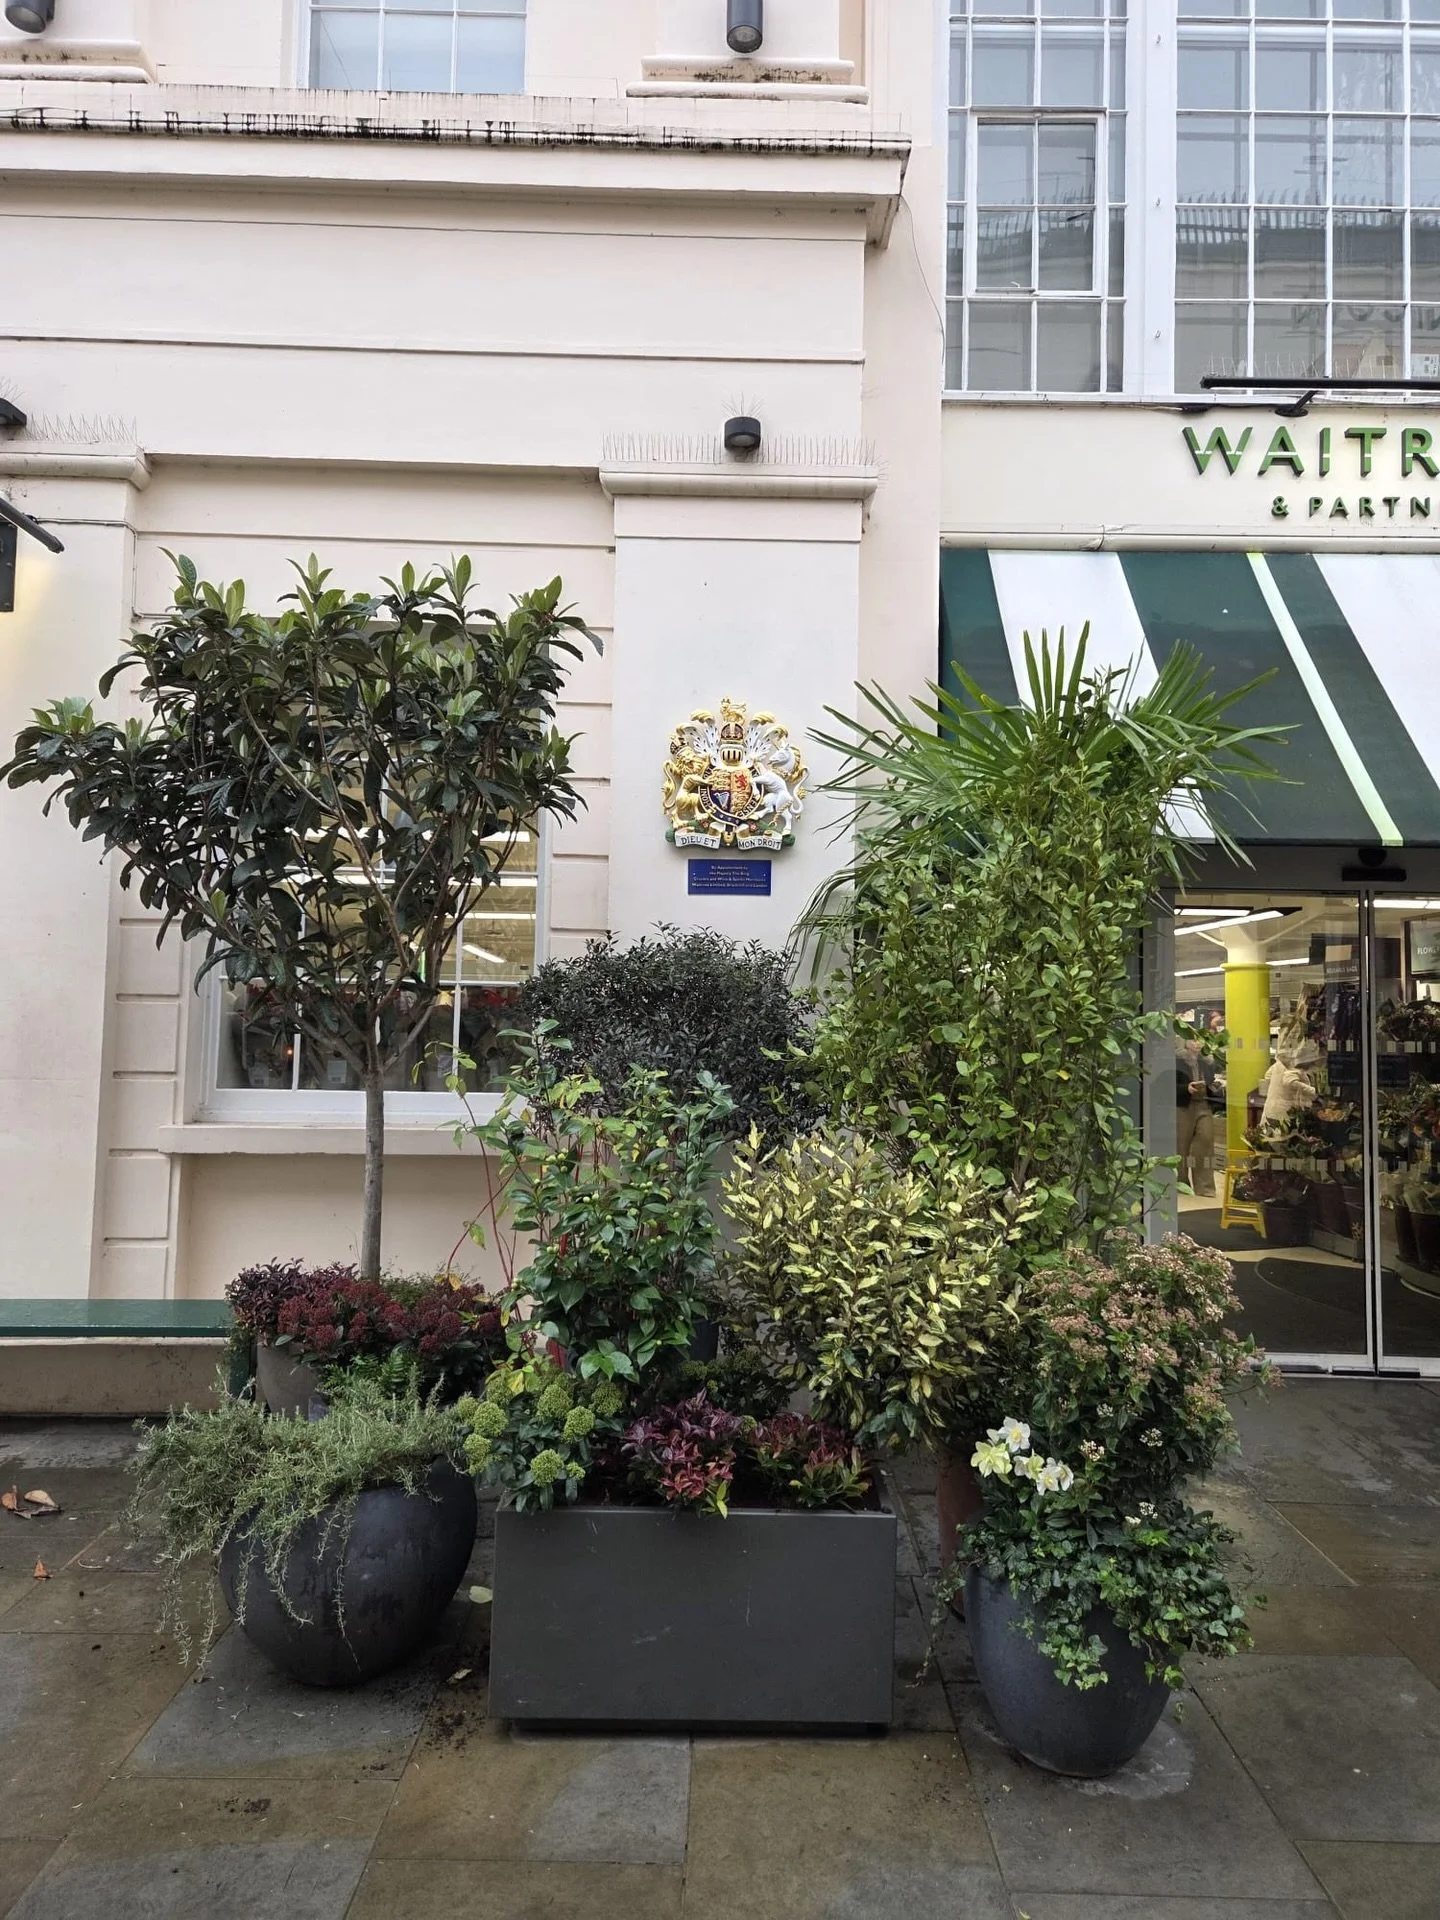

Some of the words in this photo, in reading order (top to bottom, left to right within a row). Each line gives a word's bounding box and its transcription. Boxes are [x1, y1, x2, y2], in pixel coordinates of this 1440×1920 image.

[1182, 426, 1440, 477] WAITR
[1271, 495, 1289, 516] &
[1308, 496, 1431, 518] PARTN
[680, 836, 701, 845] DIEU
[704, 837, 717, 847] ET
[738, 840, 755, 849] MON
[758, 838, 781, 849] DROIT
